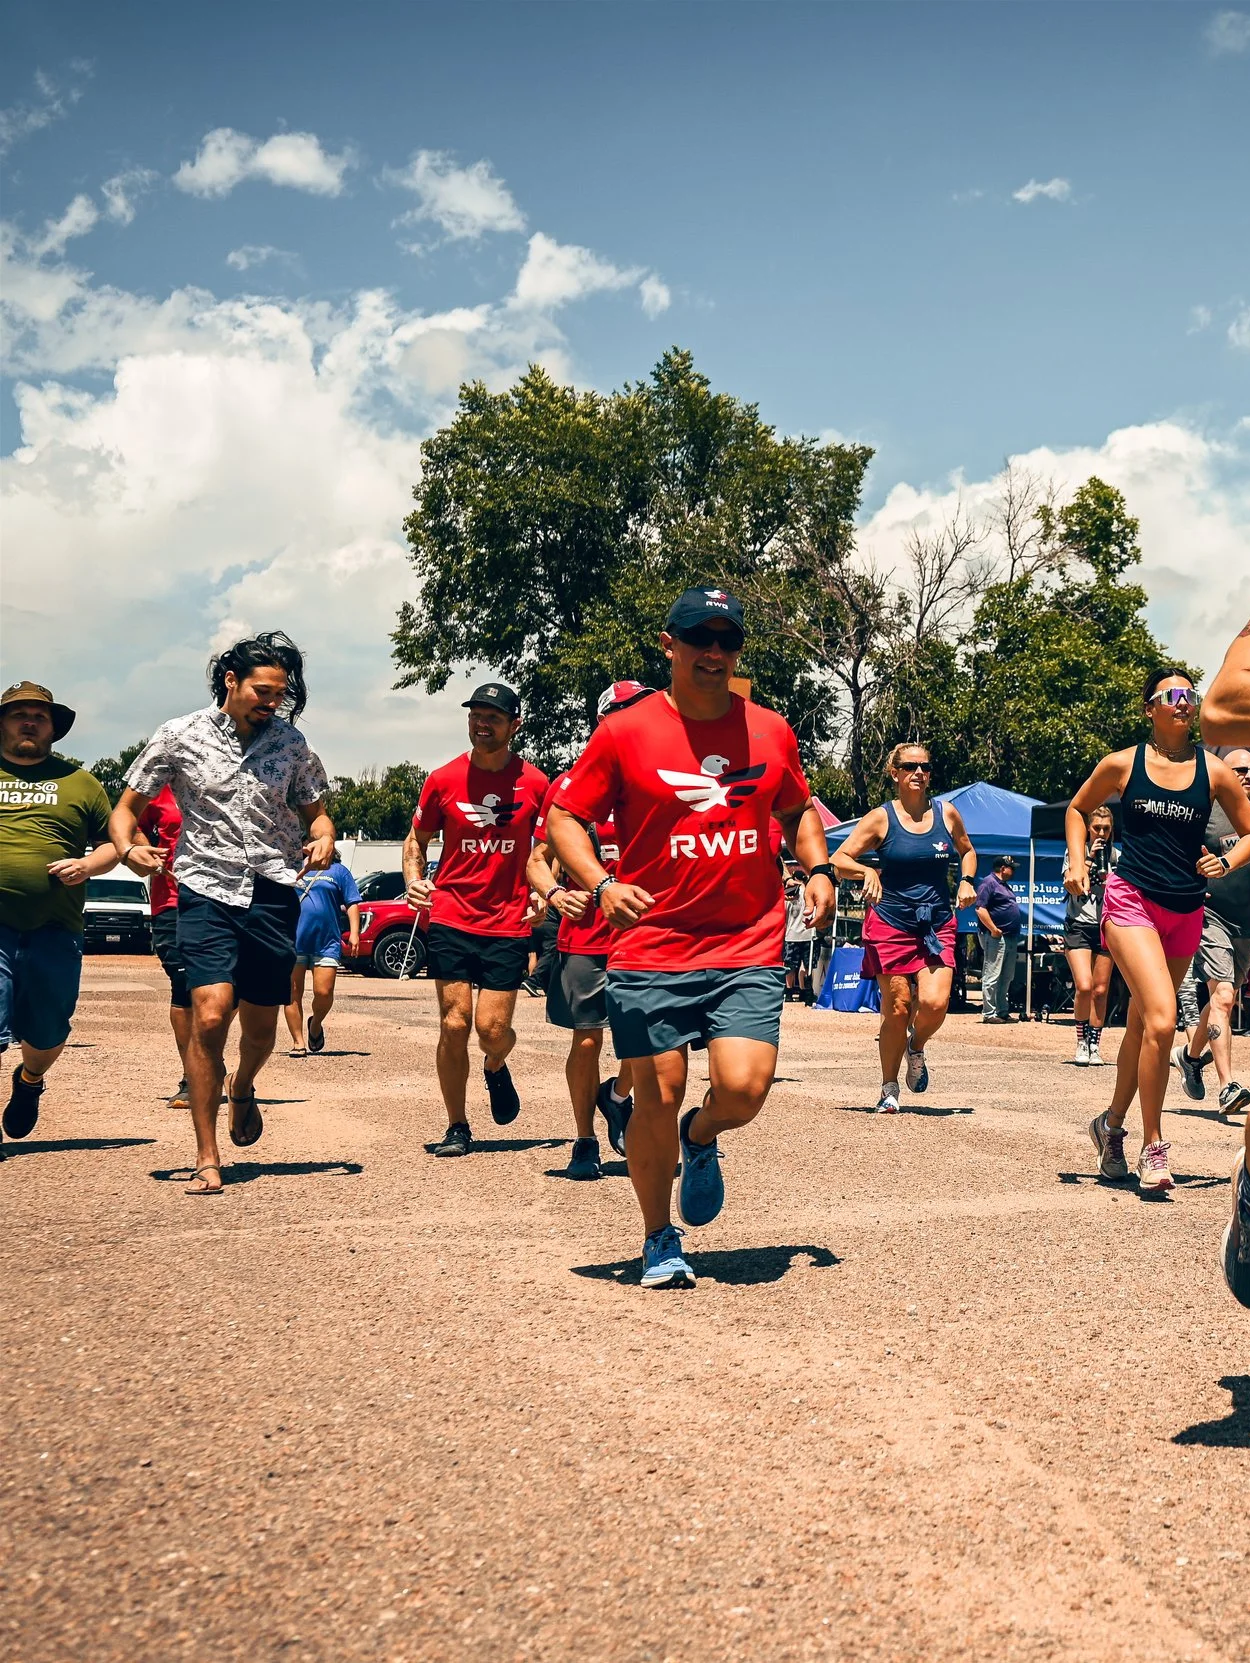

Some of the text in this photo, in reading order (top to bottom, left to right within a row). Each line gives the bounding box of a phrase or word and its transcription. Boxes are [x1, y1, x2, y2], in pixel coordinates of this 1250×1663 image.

[0, 779, 59, 794] rriors@
[1151, 800, 1195, 821] MURPH
[461, 838, 516, 854] RWB
[670, 829, 758, 859] RWB
